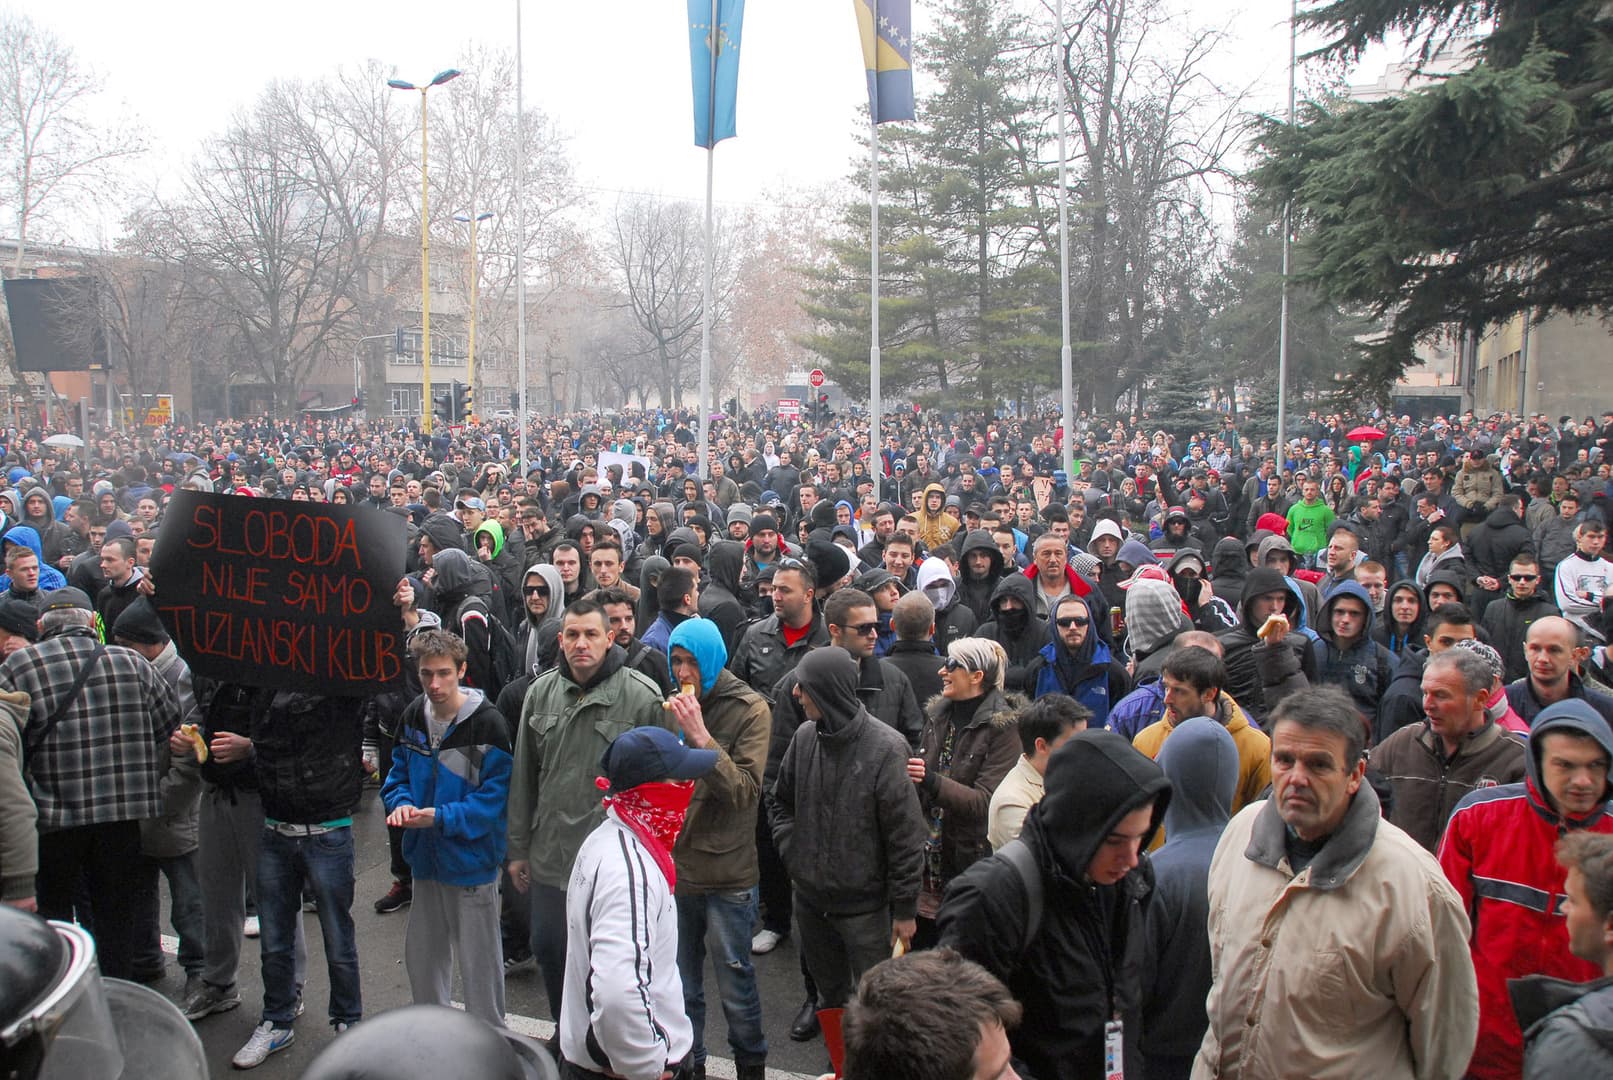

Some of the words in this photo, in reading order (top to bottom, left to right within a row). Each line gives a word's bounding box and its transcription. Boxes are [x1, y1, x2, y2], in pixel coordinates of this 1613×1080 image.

[811, 375, 822, 383] STOP
[187, 504, 363, 570] SLOBODA
[202, 561, 271, 605] NIJE
[282, 570, 372, 616] SAMO
[158, 605, 316, 674] TUZLANSKI
[328, 625, 401, 682] KLUB
